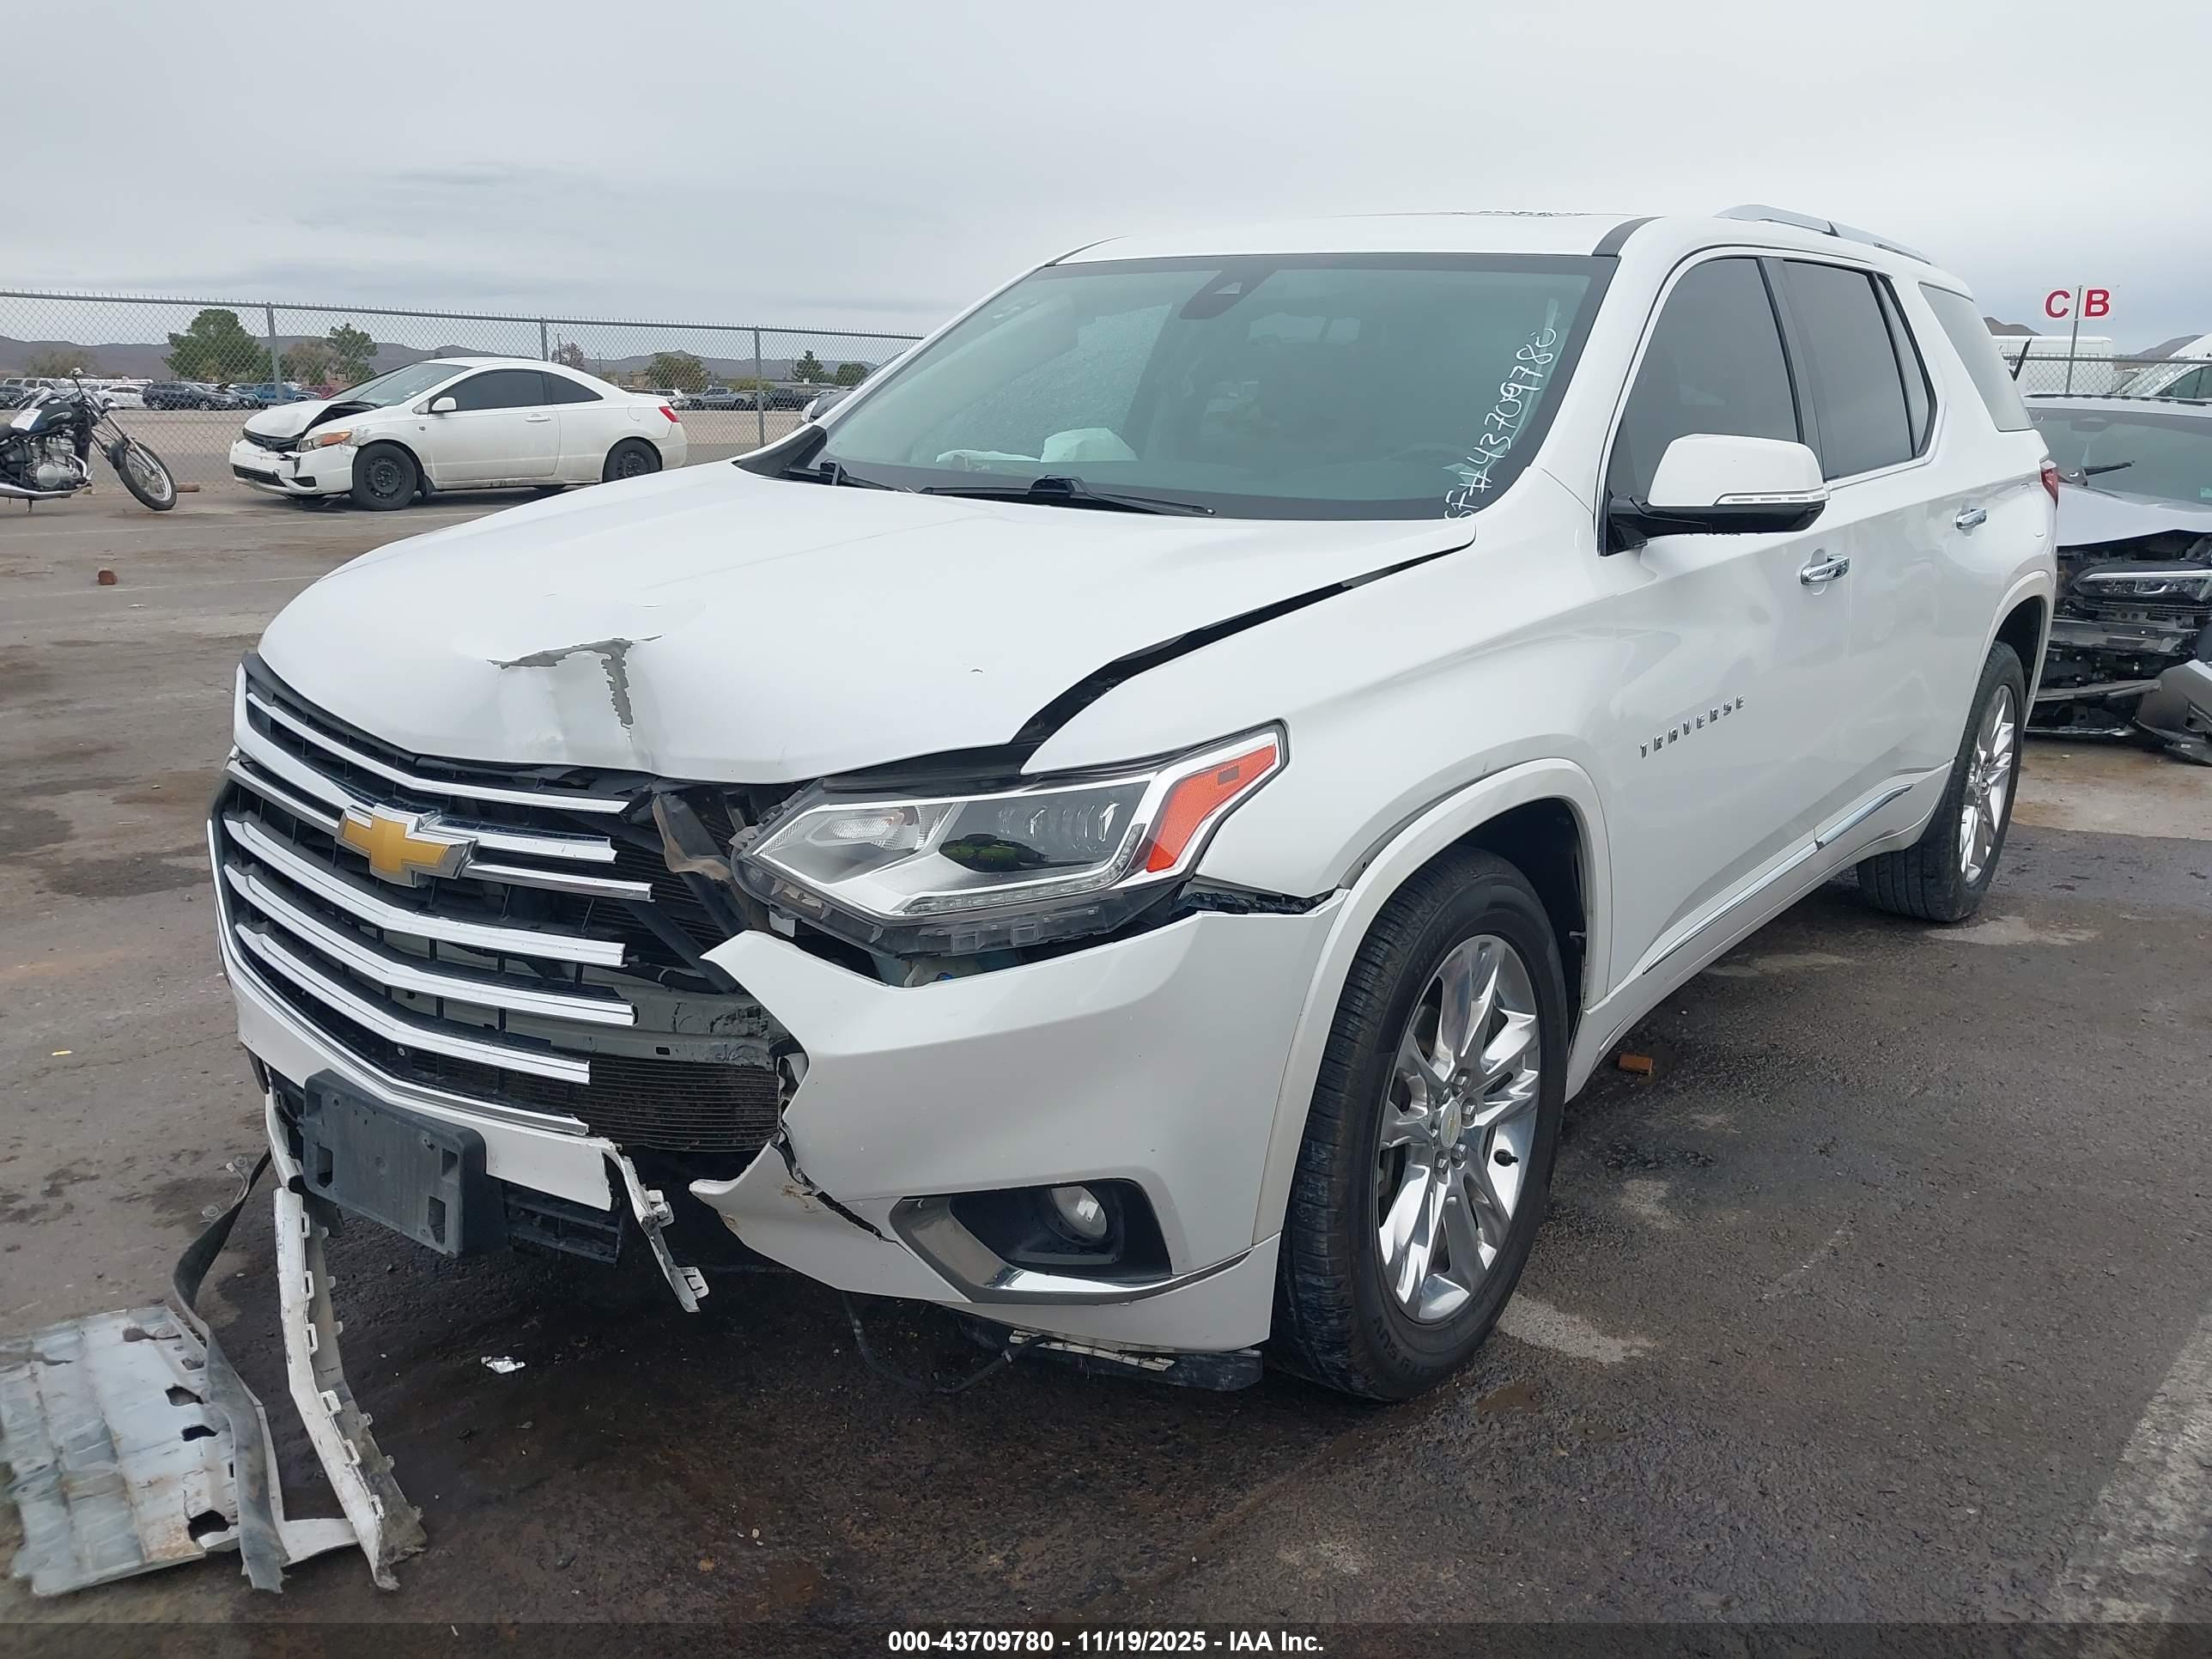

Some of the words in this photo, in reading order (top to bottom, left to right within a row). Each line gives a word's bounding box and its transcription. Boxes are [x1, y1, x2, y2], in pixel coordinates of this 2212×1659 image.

[2045, 289, 2071, 319] C
[2084, 289, 2110, 317] B
[1639, 694, 1745, 759] TRAVERSE
